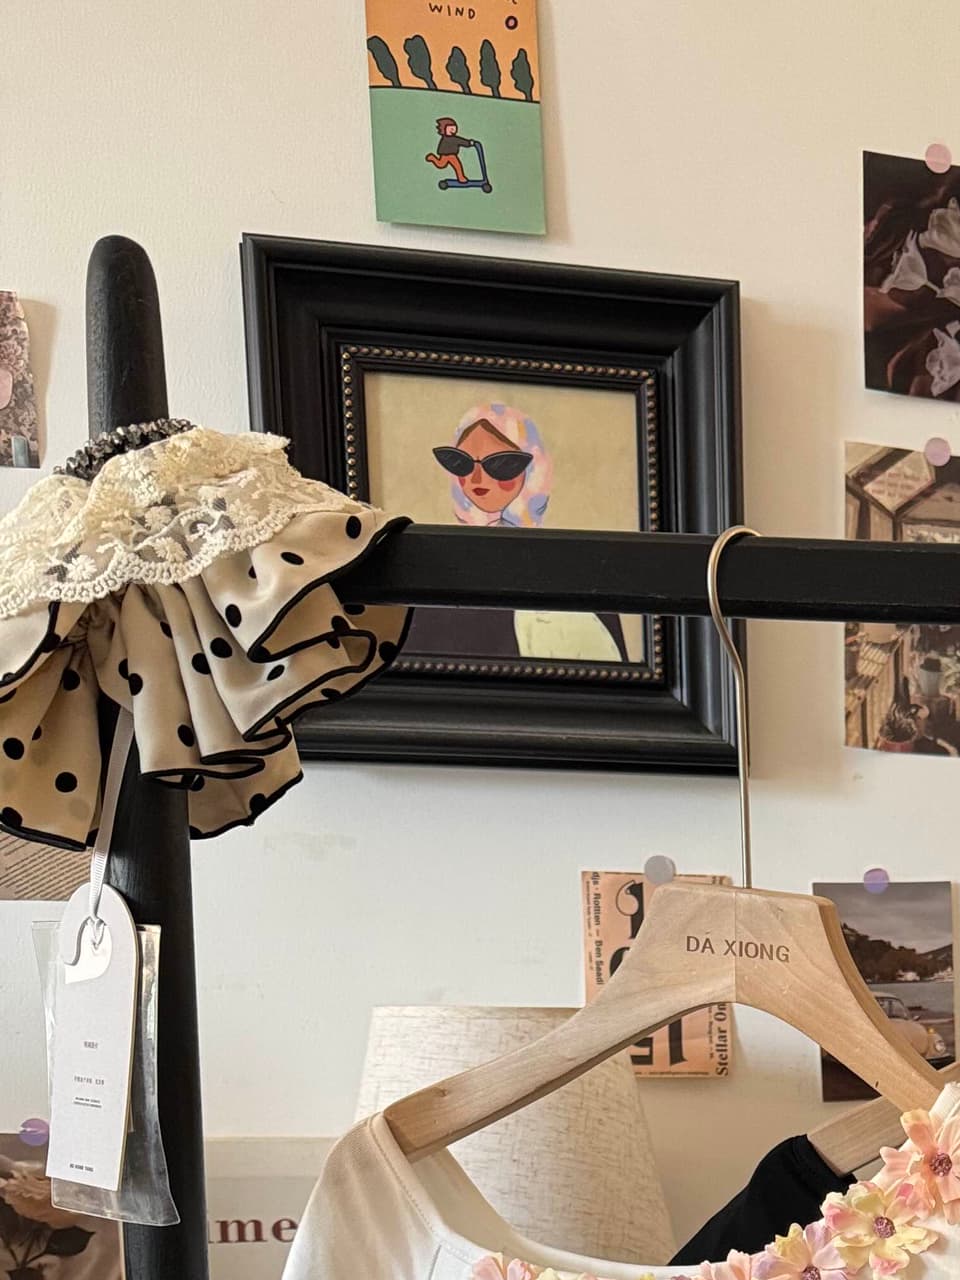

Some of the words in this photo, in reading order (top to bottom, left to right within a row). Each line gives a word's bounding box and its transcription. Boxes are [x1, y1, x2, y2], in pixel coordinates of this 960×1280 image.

[428, 3, 476, 19] WIND
[723, 939, 790, 963] XIONG
[715, 1027, 729, 1076] Stellar
[207, 1218, 299, 1244] me
